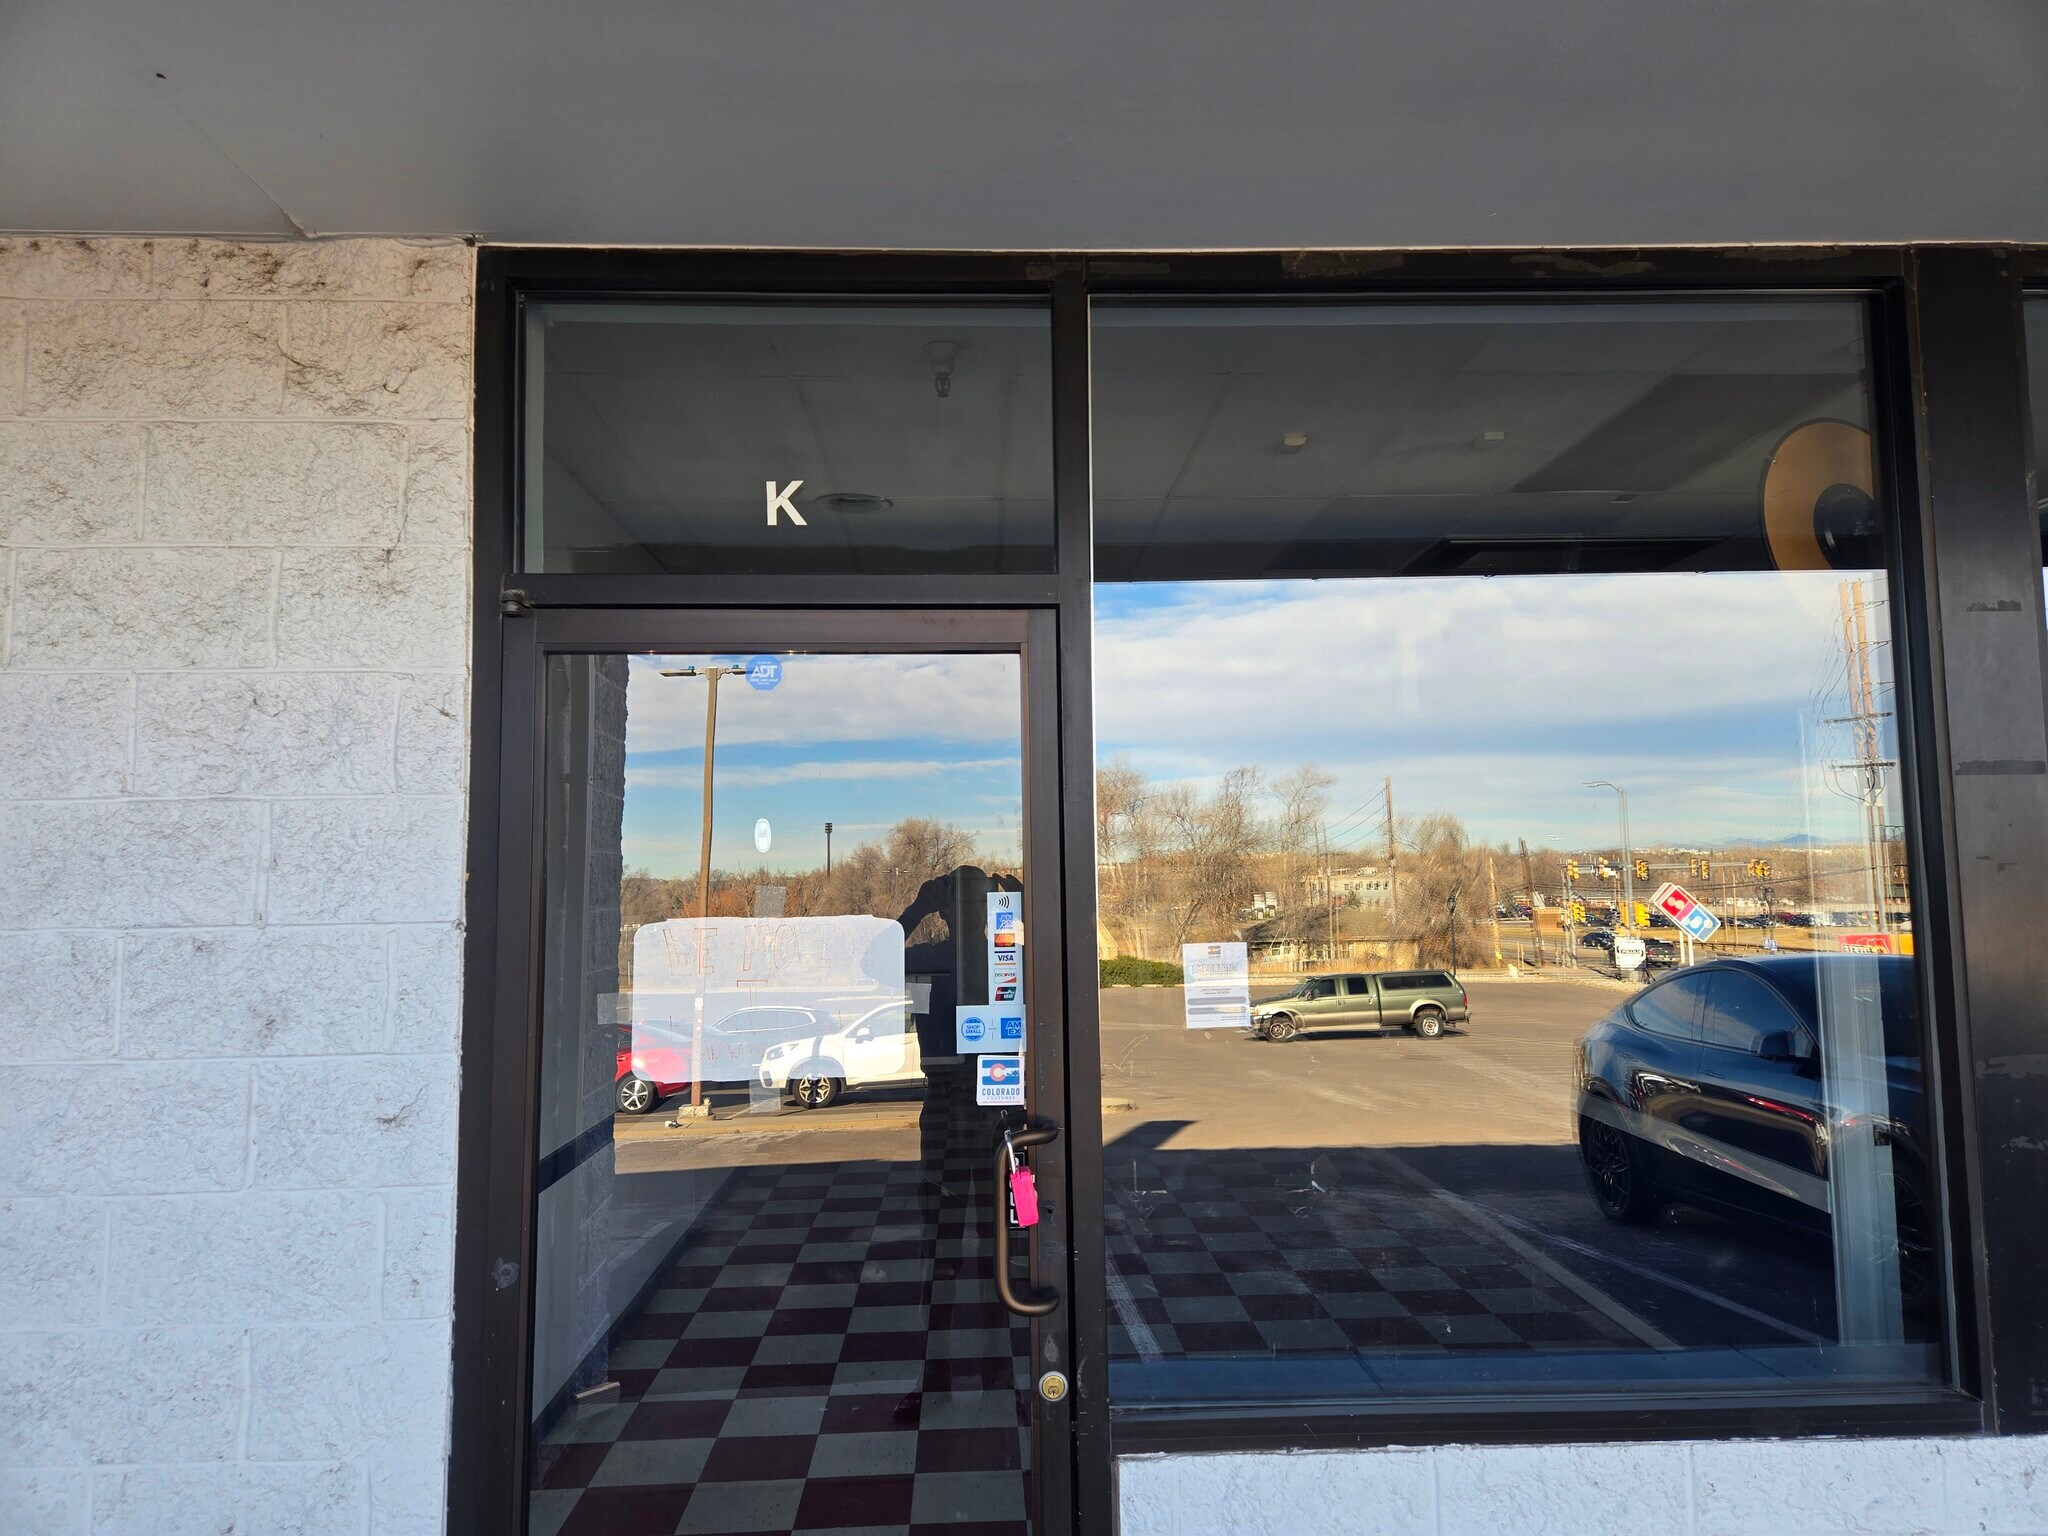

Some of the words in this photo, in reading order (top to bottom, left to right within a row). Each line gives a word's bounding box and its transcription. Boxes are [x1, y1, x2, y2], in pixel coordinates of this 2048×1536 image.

[766, 480, 808, 526] K
[751, 664, 778, 678] ADT
[662, 926, 718, 977] WE
[997, 954, 1015, 962] VISA
[1006, 1020, 1022, 1029] AM
[981, 1087, 1021, 1096] COLORADO
